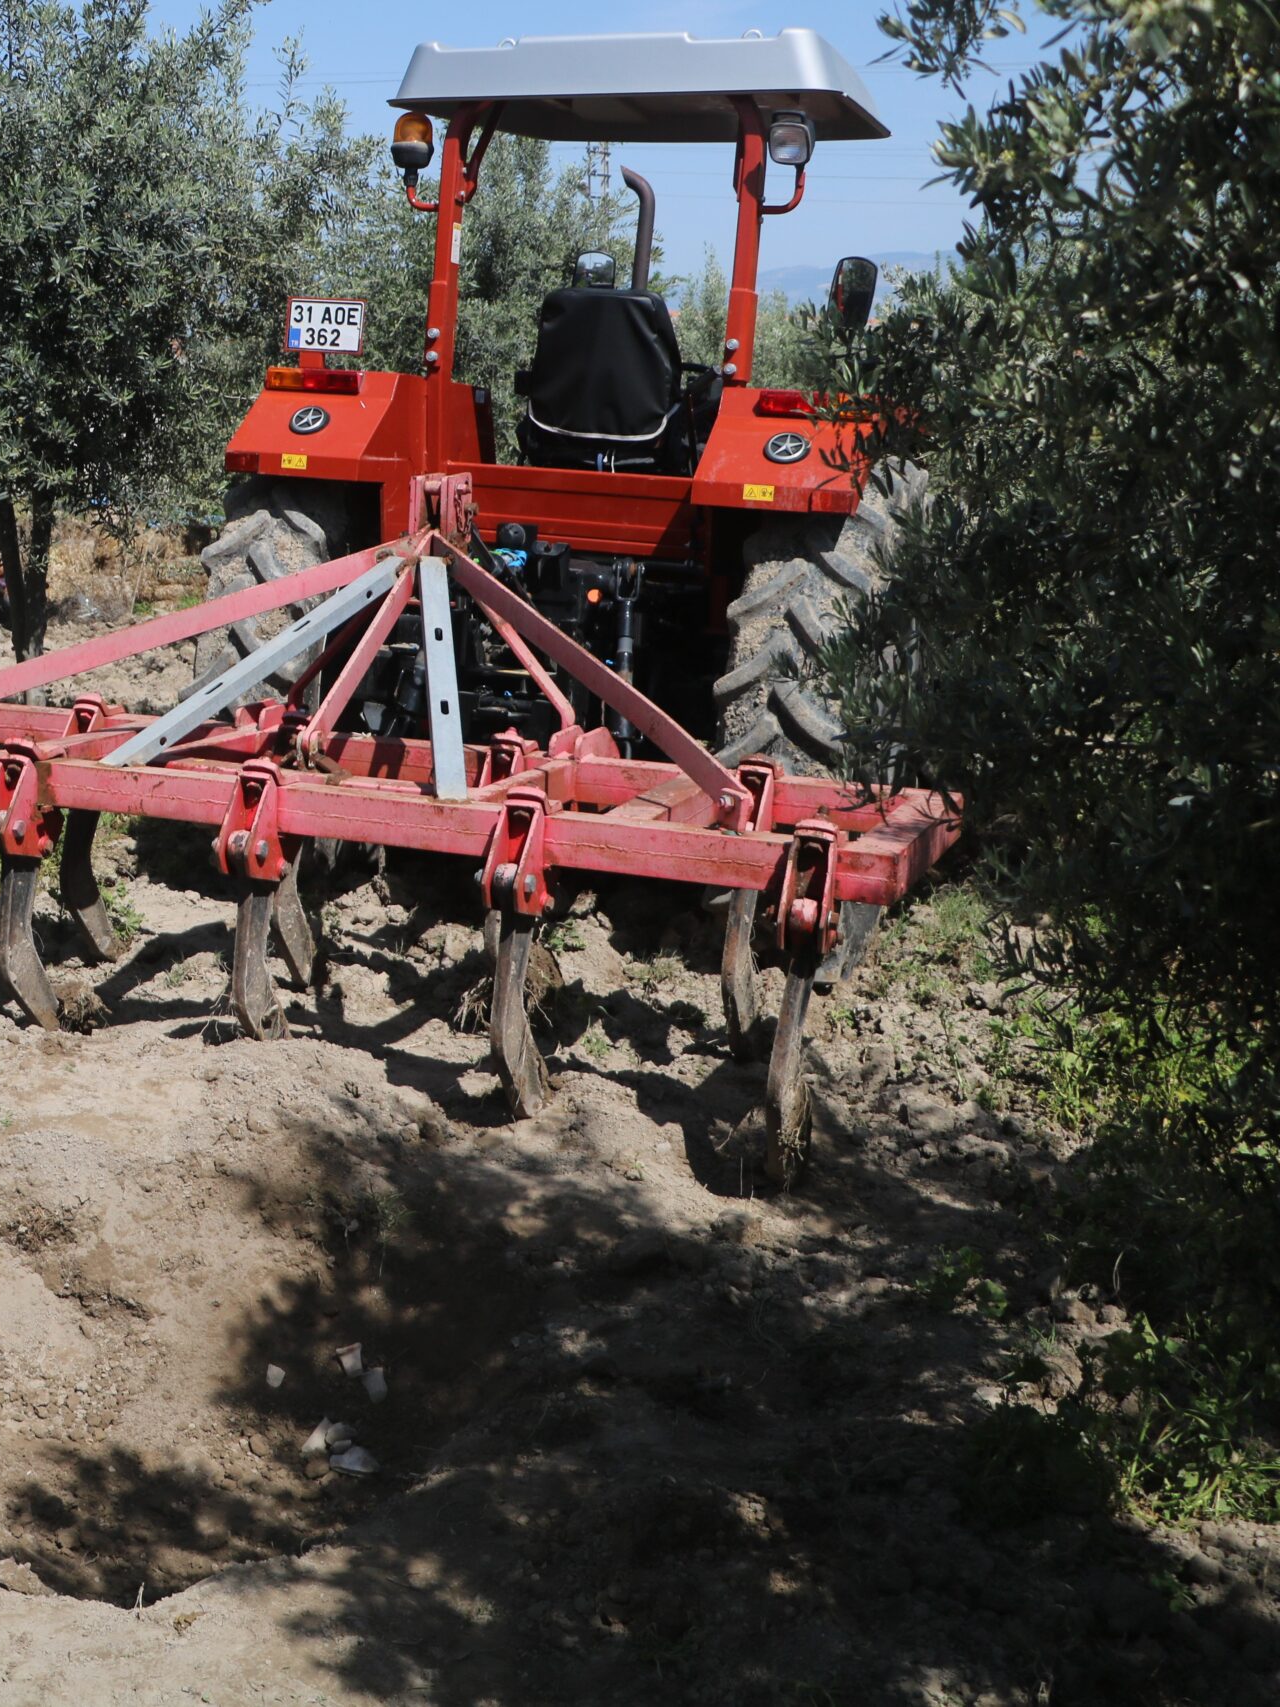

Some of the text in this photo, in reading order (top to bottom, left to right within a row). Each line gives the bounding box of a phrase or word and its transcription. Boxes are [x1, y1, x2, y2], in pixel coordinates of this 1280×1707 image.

[293, 305, 359, 326] 31 AOE
[305, 327, 341, 347] 362
